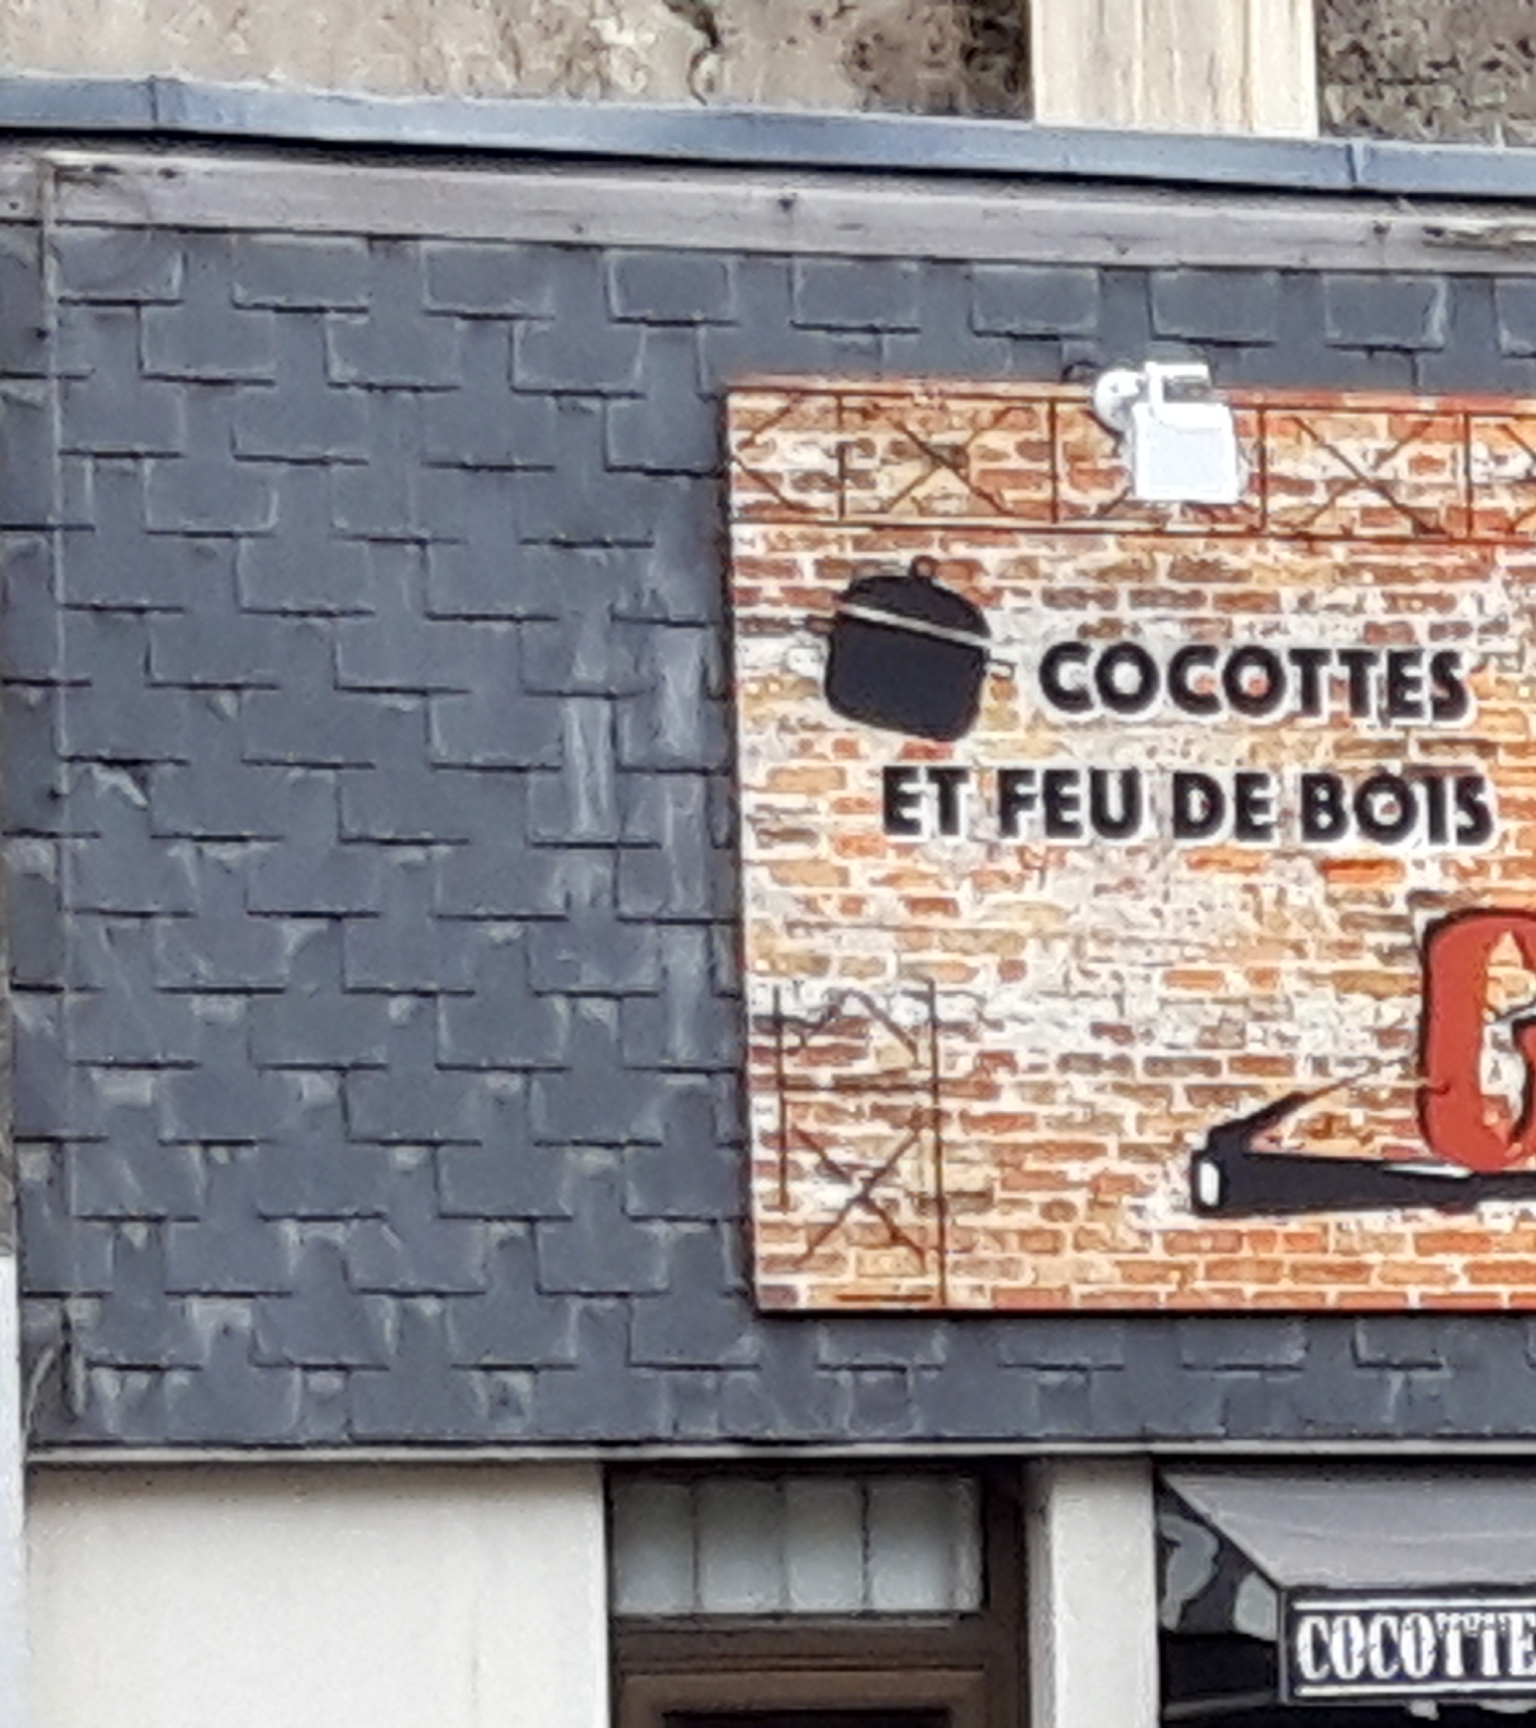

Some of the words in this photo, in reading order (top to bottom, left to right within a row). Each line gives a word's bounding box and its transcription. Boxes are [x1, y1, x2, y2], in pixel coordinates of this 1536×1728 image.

[1038, 640, 1472, 723] COCOTTES
[881, 765, 969, 836] ET
[1000, 767, 1142, 839] FEU
[1172, 770, 1278, 841] DE
[1301, 773, 1496, 847] BOIS
